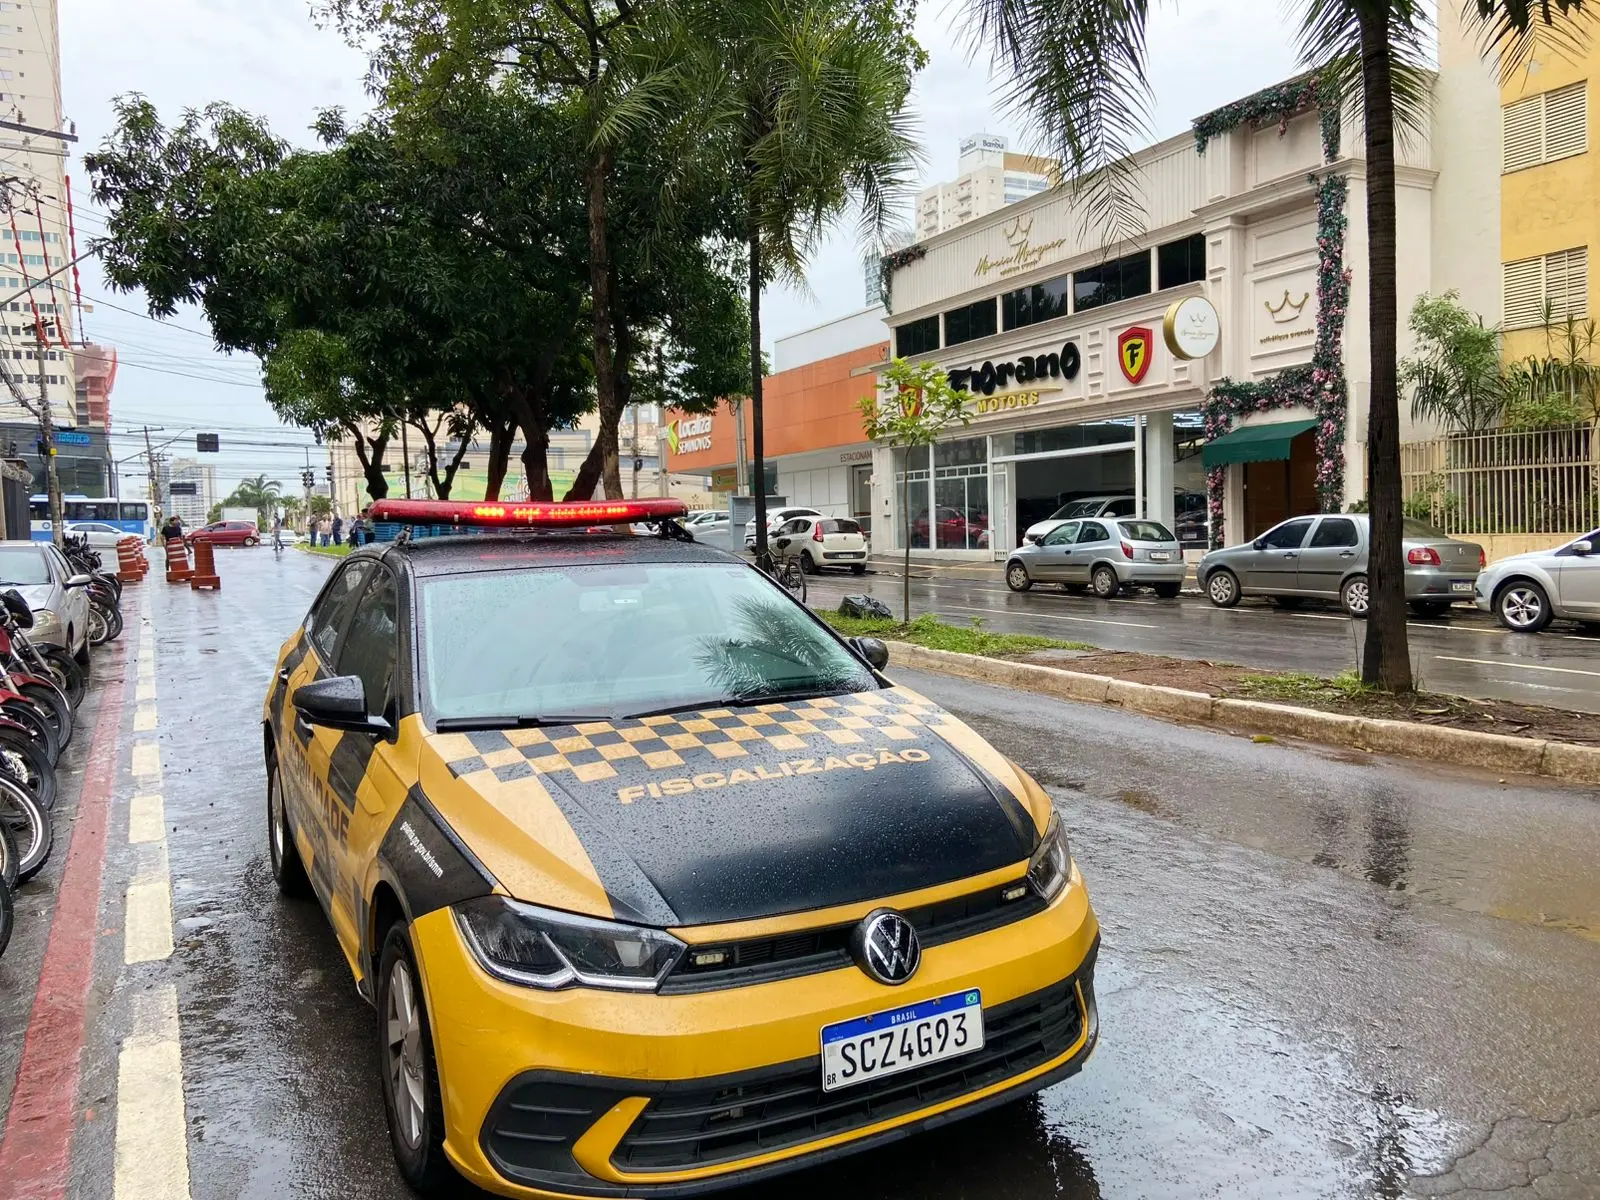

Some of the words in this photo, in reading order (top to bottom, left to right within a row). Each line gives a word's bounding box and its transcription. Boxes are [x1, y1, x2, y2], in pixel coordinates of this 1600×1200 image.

[1125, 342, 1143, 369] F
[976, 391, 1039, 413] MOTORS
[678, 415, 713, 439] Localiza
[678, 436, 712, 455] SEMINOVOS
[617, 748, 931, 805] FISCALIZAÇÃO
[891, 1010, 917, 1024] BRASIL
[841, 1013, 968, 1078] SCZ4G93
[826, 1073, 837, 1085] BR
